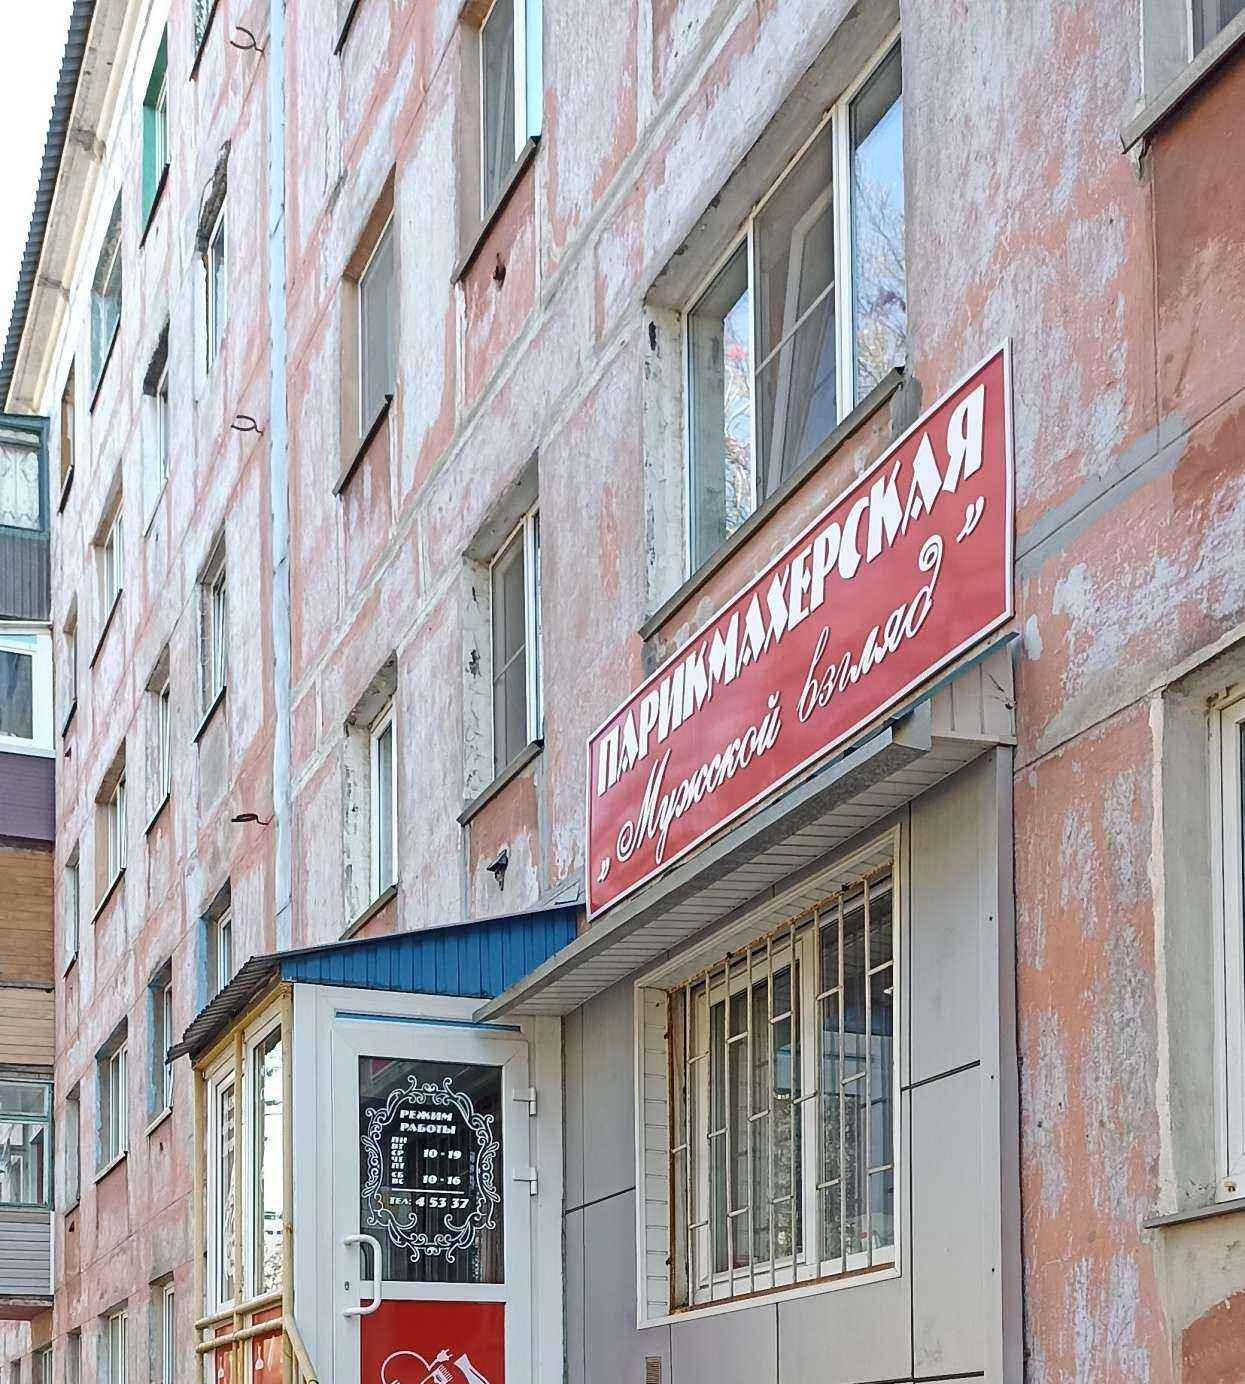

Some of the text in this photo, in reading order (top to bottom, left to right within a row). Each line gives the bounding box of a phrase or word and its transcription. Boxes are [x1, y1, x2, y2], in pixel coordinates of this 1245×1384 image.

[596, 383, 985, 797] ПАРИКМАХЕРСКАЯ
[400, 1109, 453, 1122] РЕЖИМ
[400, 1122, 456, 1134] РАБОТЫ
[391, 1136, 408, 1144] ПН
[423, 1149, 438, 1158] 10
[448, 1150, 462, 1159] 19
[422, 1175, 438, 1184] 10
[447, 1176, 462, 1185] 16
[415, 1197, 425, 1207] 4
[429, 1197, 447, 1208] 53
[451, 1198, 469, 1209] 37
